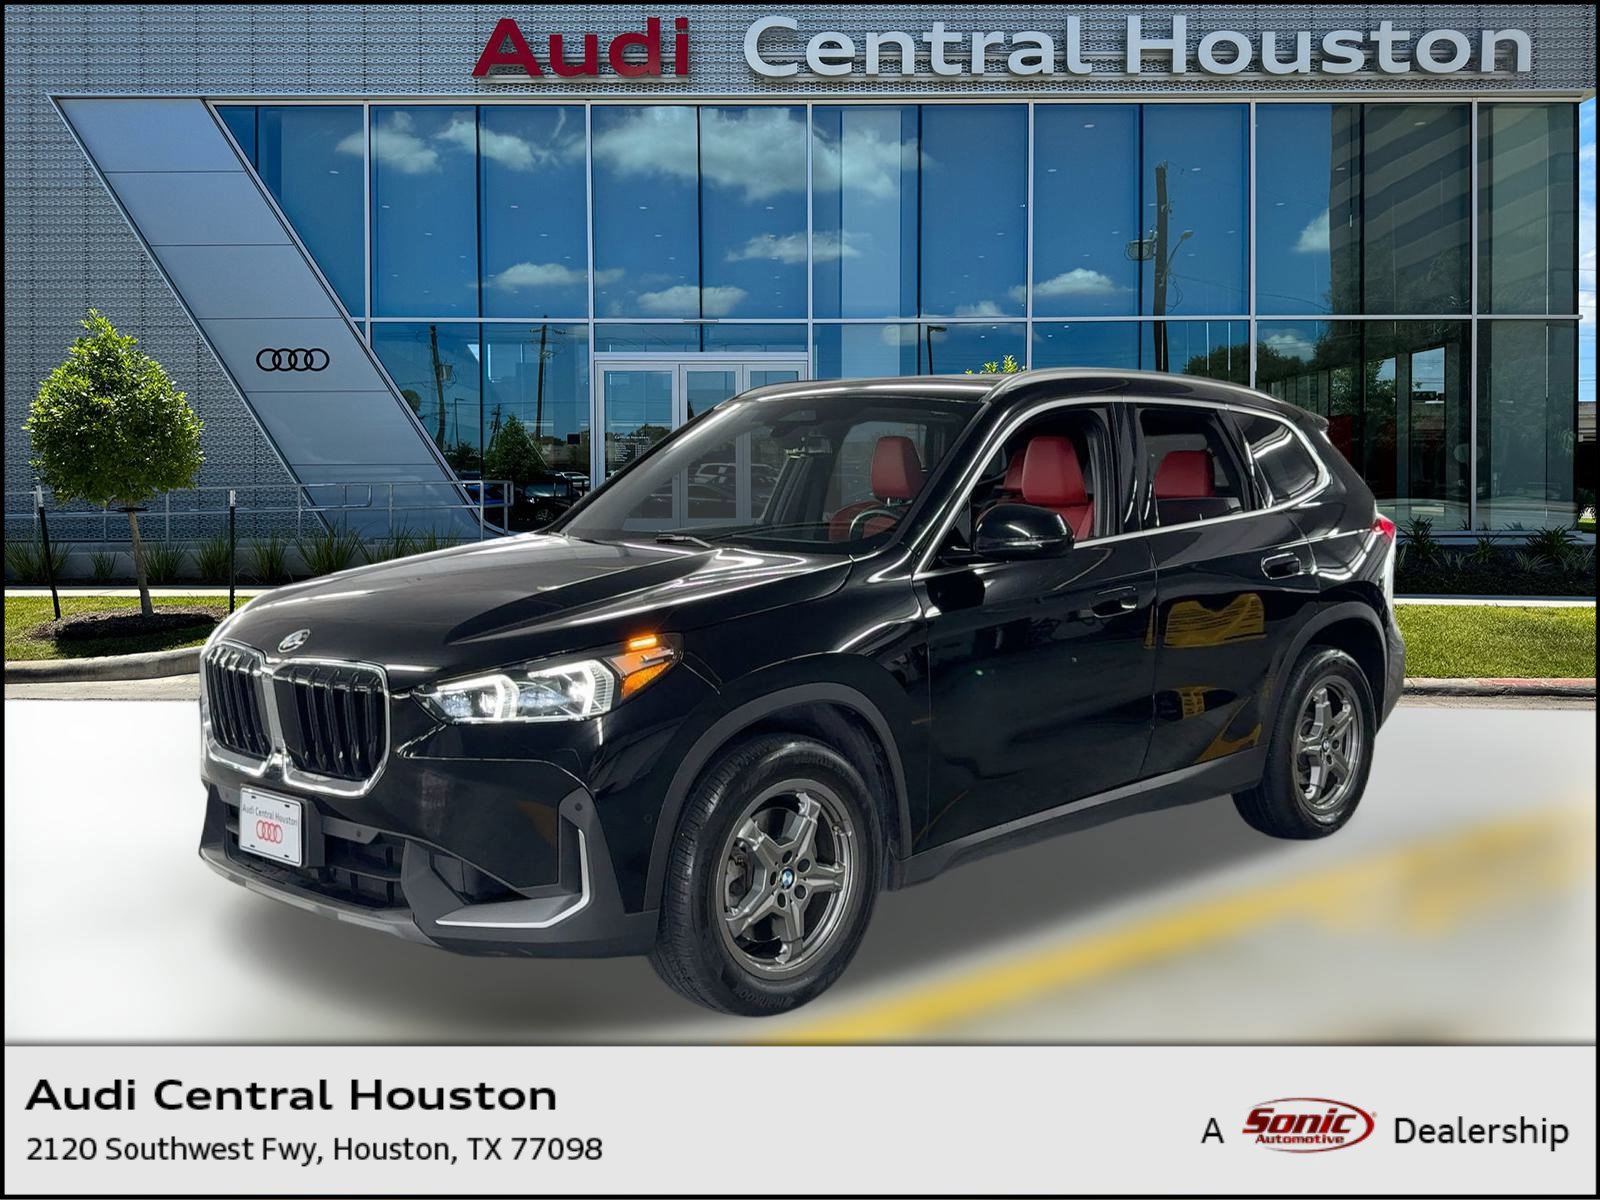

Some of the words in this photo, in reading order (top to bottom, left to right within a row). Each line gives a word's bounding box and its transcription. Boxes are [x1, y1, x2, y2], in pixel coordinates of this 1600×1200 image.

[473, 17, 689, 77] Audi
[743, 15, 1093, 77] Central
[1126, 15, 1532, 75] Houston
[242, 804, 254, 815] Audi
[255, 807, 274, 820] Central
[275, 812, 298, 826] Houston
